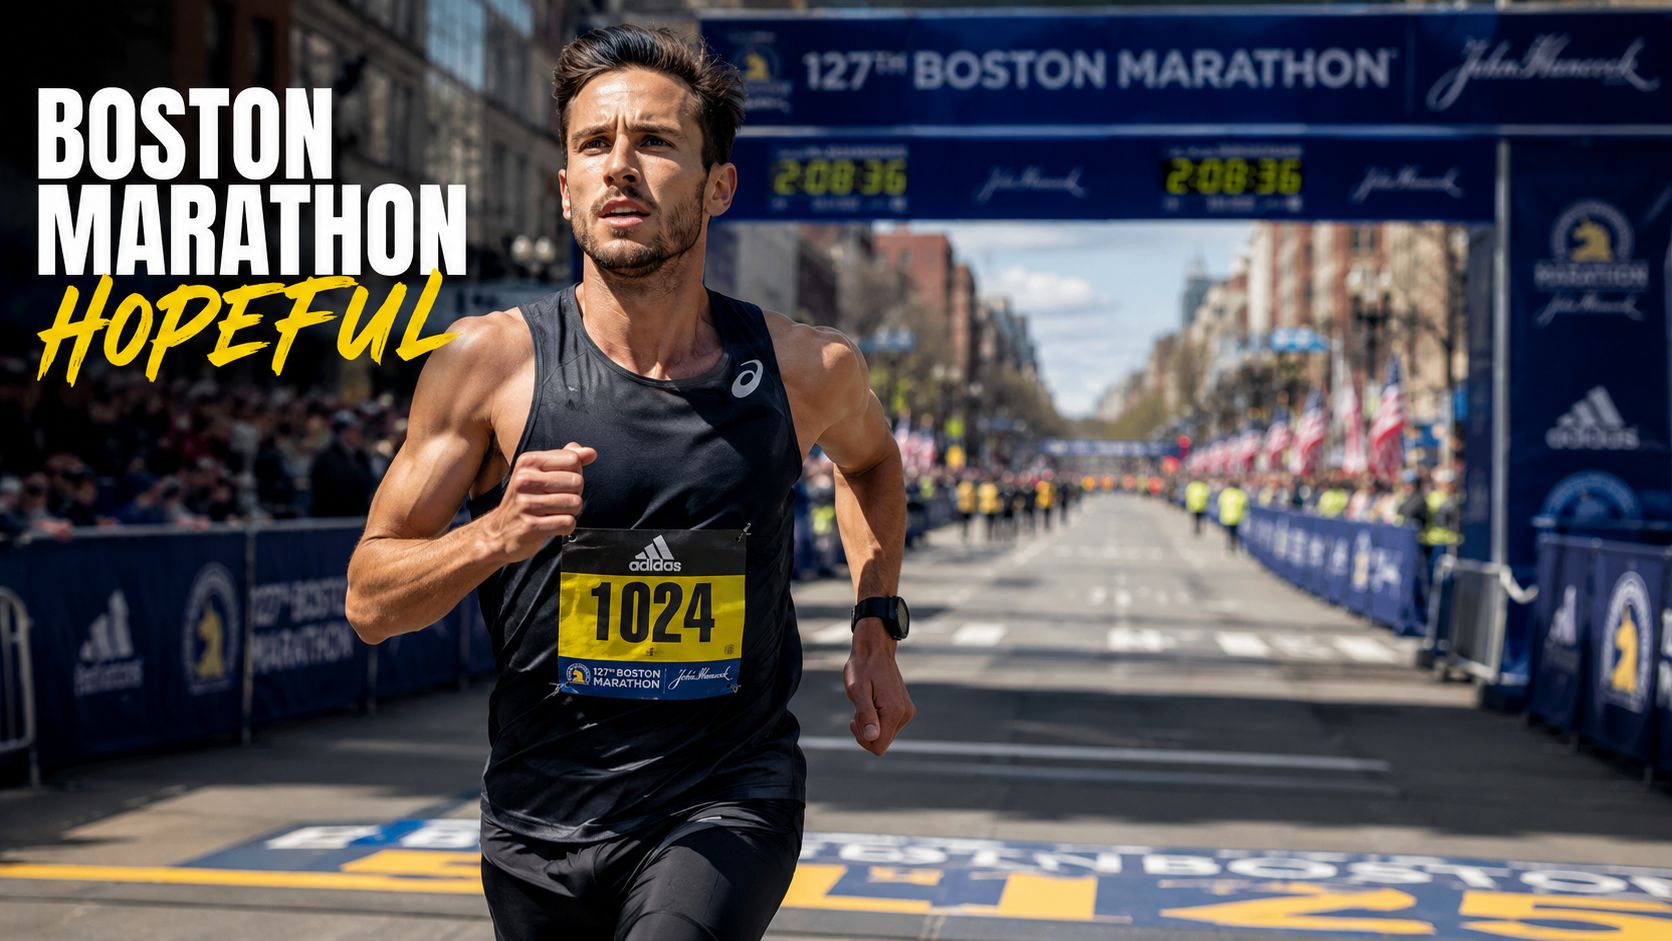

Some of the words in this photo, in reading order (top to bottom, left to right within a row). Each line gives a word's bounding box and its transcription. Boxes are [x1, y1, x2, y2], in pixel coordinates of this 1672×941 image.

[913, 50, 1107, 91] BOSTON
[1117, 49, 1391, 89] MARATHON
[629, 558, 682, 572] adidas
[591, 581, 715, 643] 1024
[616, 668, 661, 679] BOSTON
[593, 677, 660, 689] MARATHON
